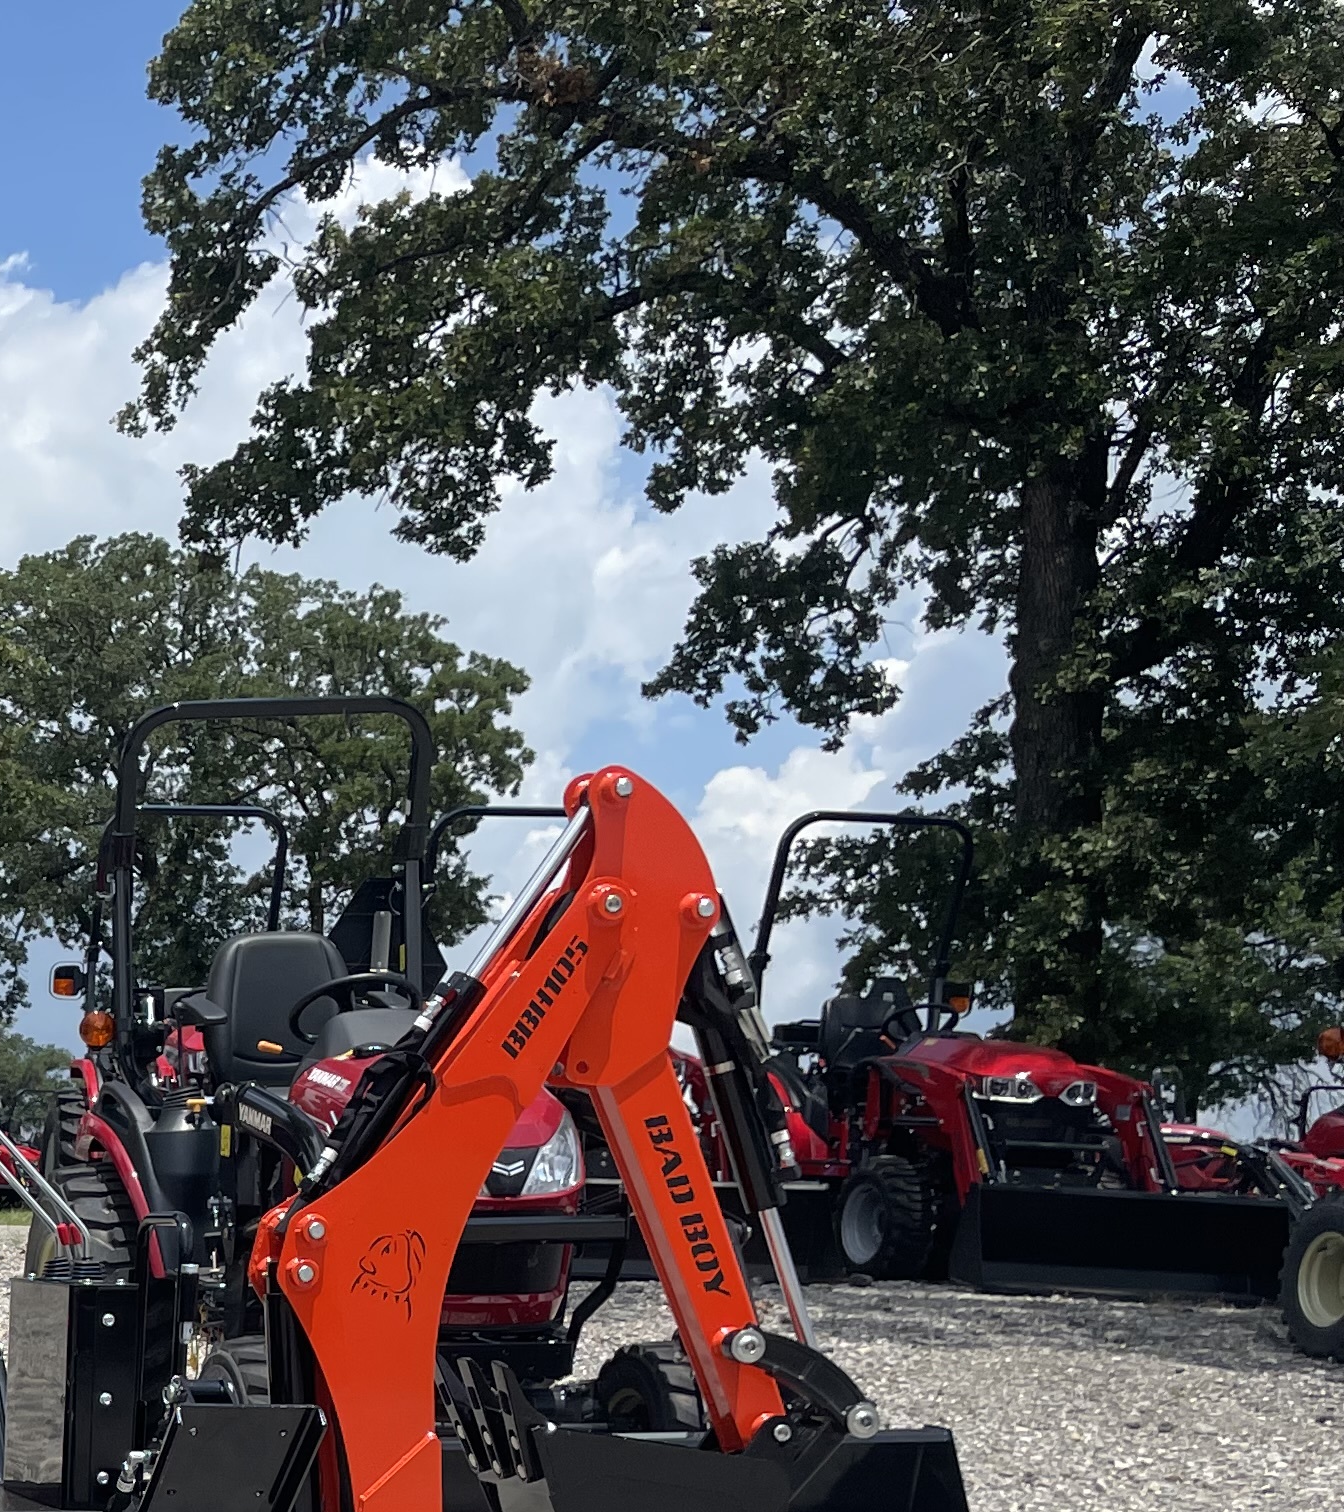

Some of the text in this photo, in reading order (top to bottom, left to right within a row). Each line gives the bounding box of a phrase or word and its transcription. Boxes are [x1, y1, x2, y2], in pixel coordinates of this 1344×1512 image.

[501, 934, 589, 1060] BBH105
[238, 1102, 272, 1135] YANMAR
[643, 1115, 732, 1297] BAD BOY
